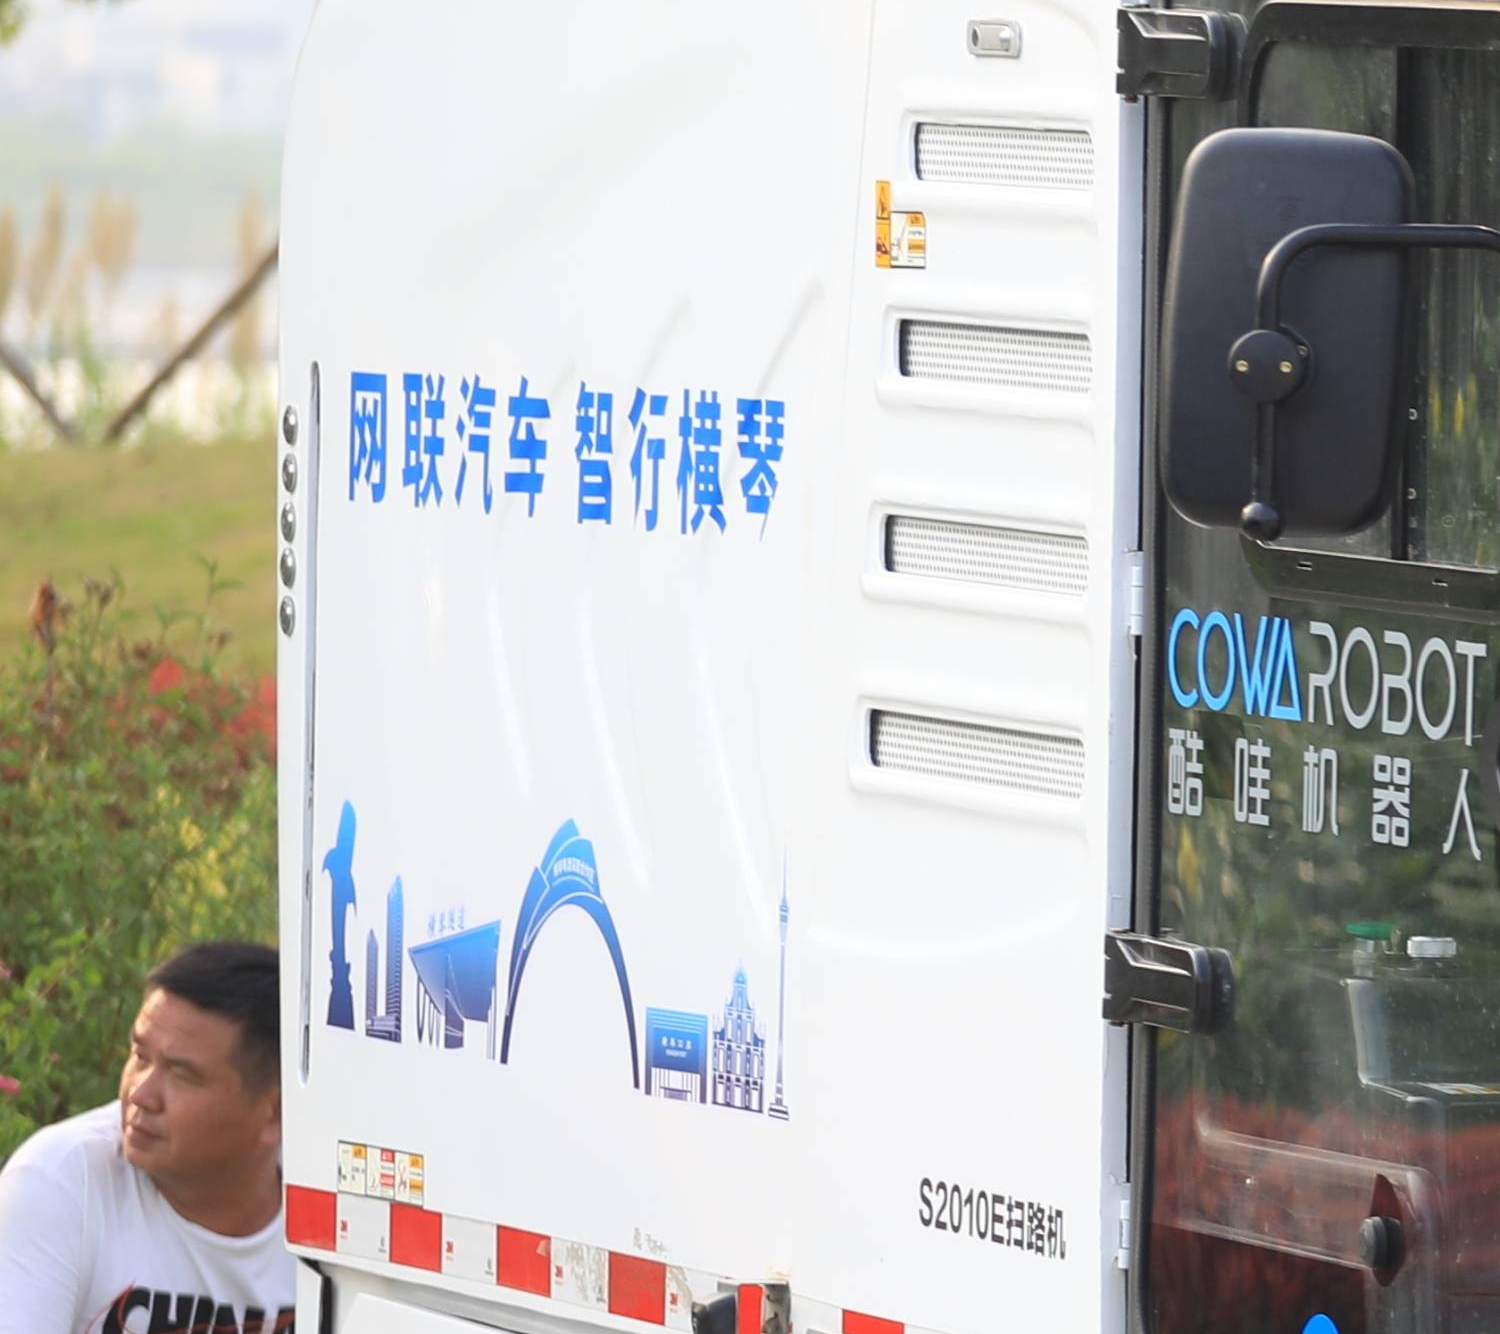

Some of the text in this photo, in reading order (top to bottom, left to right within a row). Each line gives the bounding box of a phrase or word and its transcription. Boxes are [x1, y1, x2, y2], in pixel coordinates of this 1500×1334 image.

[349, 371, 784, 541] 网联汽车 智行横琴
[1167, 727, 1483, 861] 酷哇机器人
[918, 1177, 1067, 1260] S2010E扫路机
